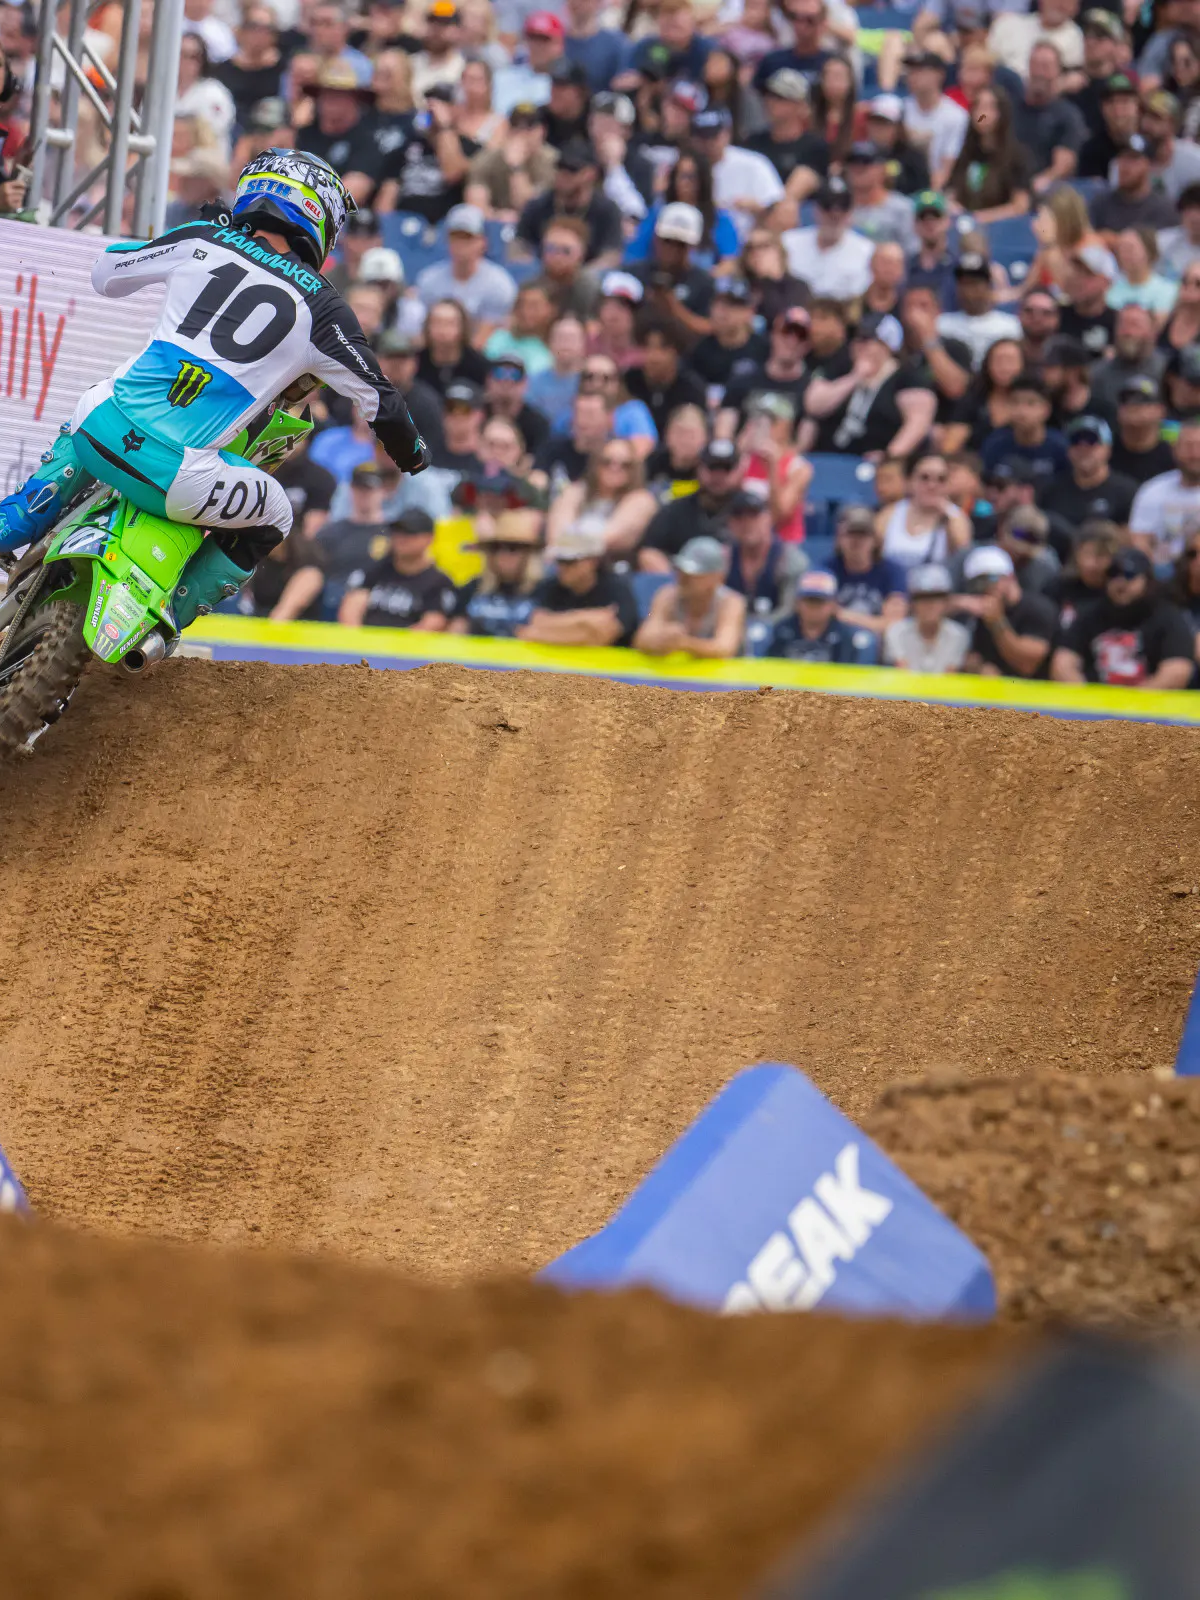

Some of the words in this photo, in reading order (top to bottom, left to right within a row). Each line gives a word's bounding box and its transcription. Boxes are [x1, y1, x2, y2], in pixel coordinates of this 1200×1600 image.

[245, 178, 292, 197] SETH
[304, 199, 322, 219] BELL
[114, 258, 136, 270] PRO
[136, 245, 178, 263] CIRCUIT
[212, 227, 323, 295] HAMMAKER
[176, 262, 297, 364] 10
[332, 323, 349, 344] PRO
[192, 480, 268, 520] FOX
[91, 595, 104, 628] DUNLOP
[119, 631, 141, 654] DUNLOP
